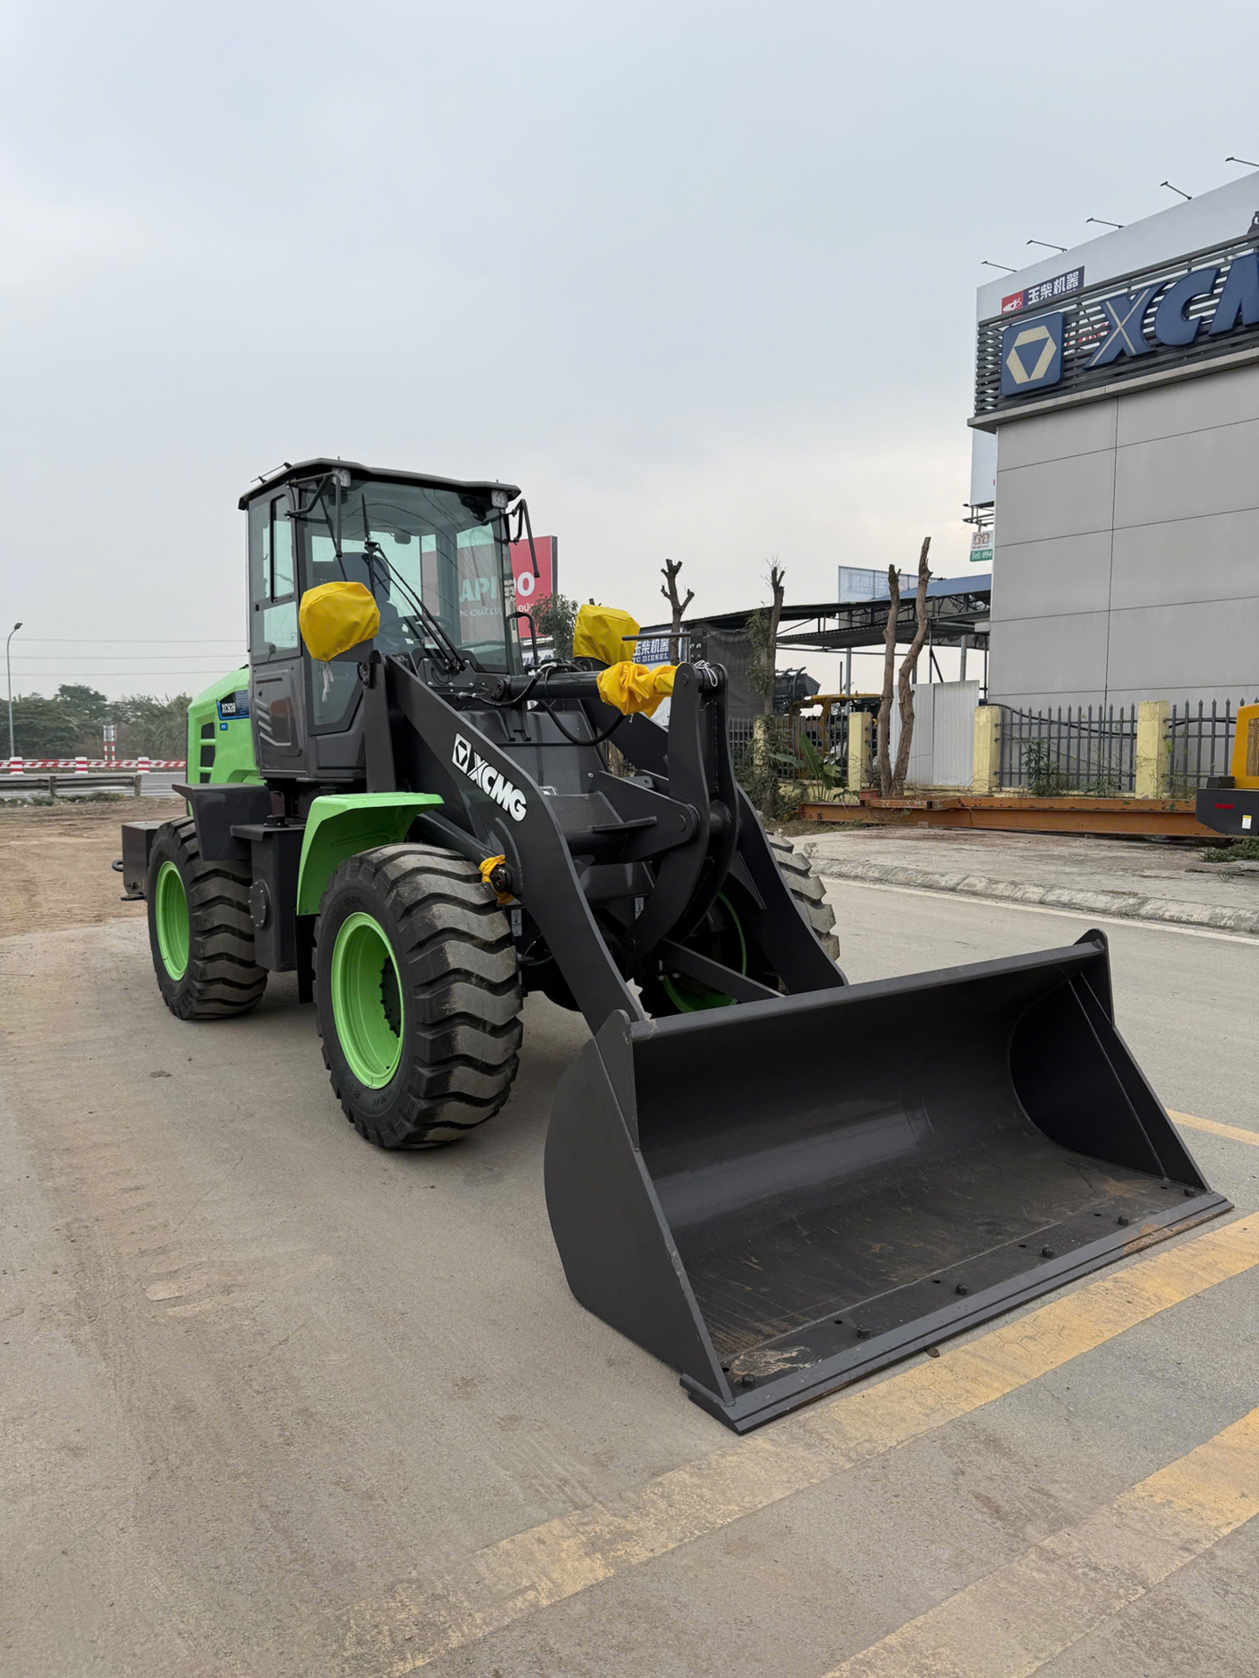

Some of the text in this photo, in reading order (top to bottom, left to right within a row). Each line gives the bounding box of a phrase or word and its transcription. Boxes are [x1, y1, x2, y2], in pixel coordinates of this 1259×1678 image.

[1027, 271, 1079, 305] 玉柴机器
[467, 752, 527, 821] XCMG
